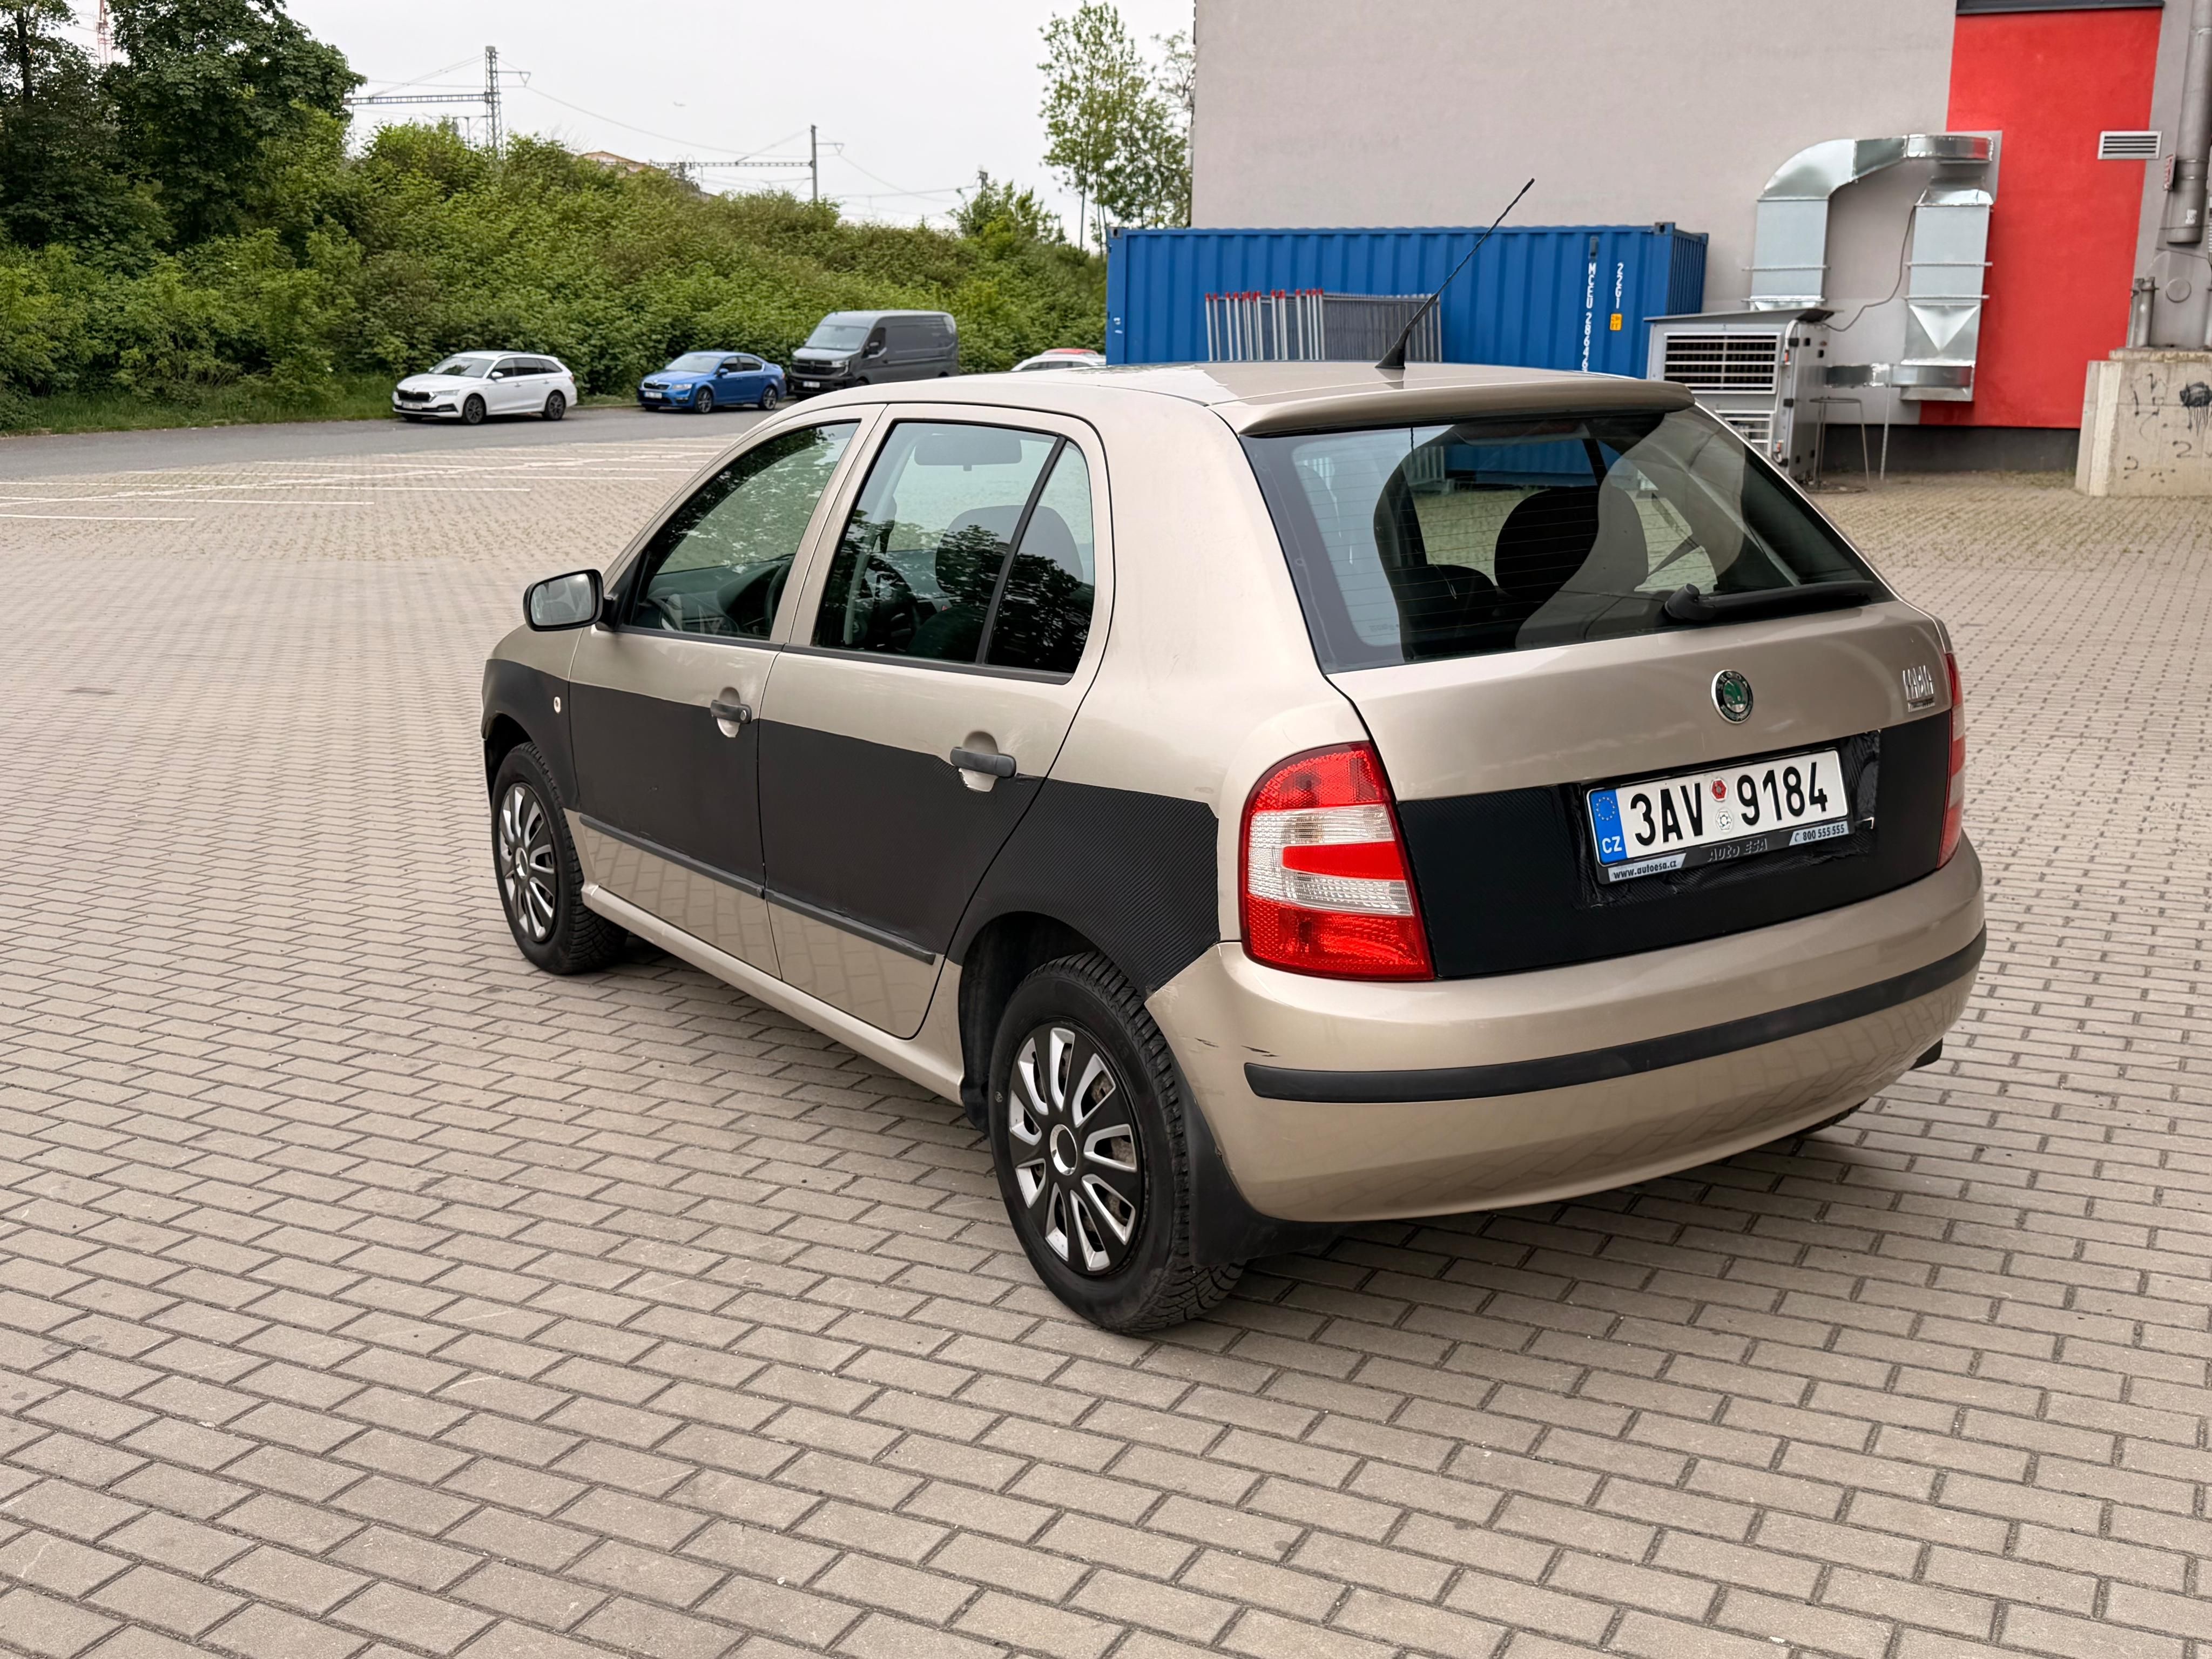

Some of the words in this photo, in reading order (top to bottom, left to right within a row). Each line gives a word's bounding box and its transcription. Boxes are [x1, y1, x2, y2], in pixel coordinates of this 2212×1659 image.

[1581, 312, 1593, 372] 28646
[1630, 782, 1703, 846] 3AV
[1736, 761, 1828, 826] 9184
[1803, 830, 1816, 841] 800
[1818, 827, 1831, 839] 555
[1832, 824, 1845, 835] 555
[1602, 836, 1622, 854] CZ
[1743, 838, 1768, 855] ESA
[1613, 860, 1677, 879] www.autoesa.cz
